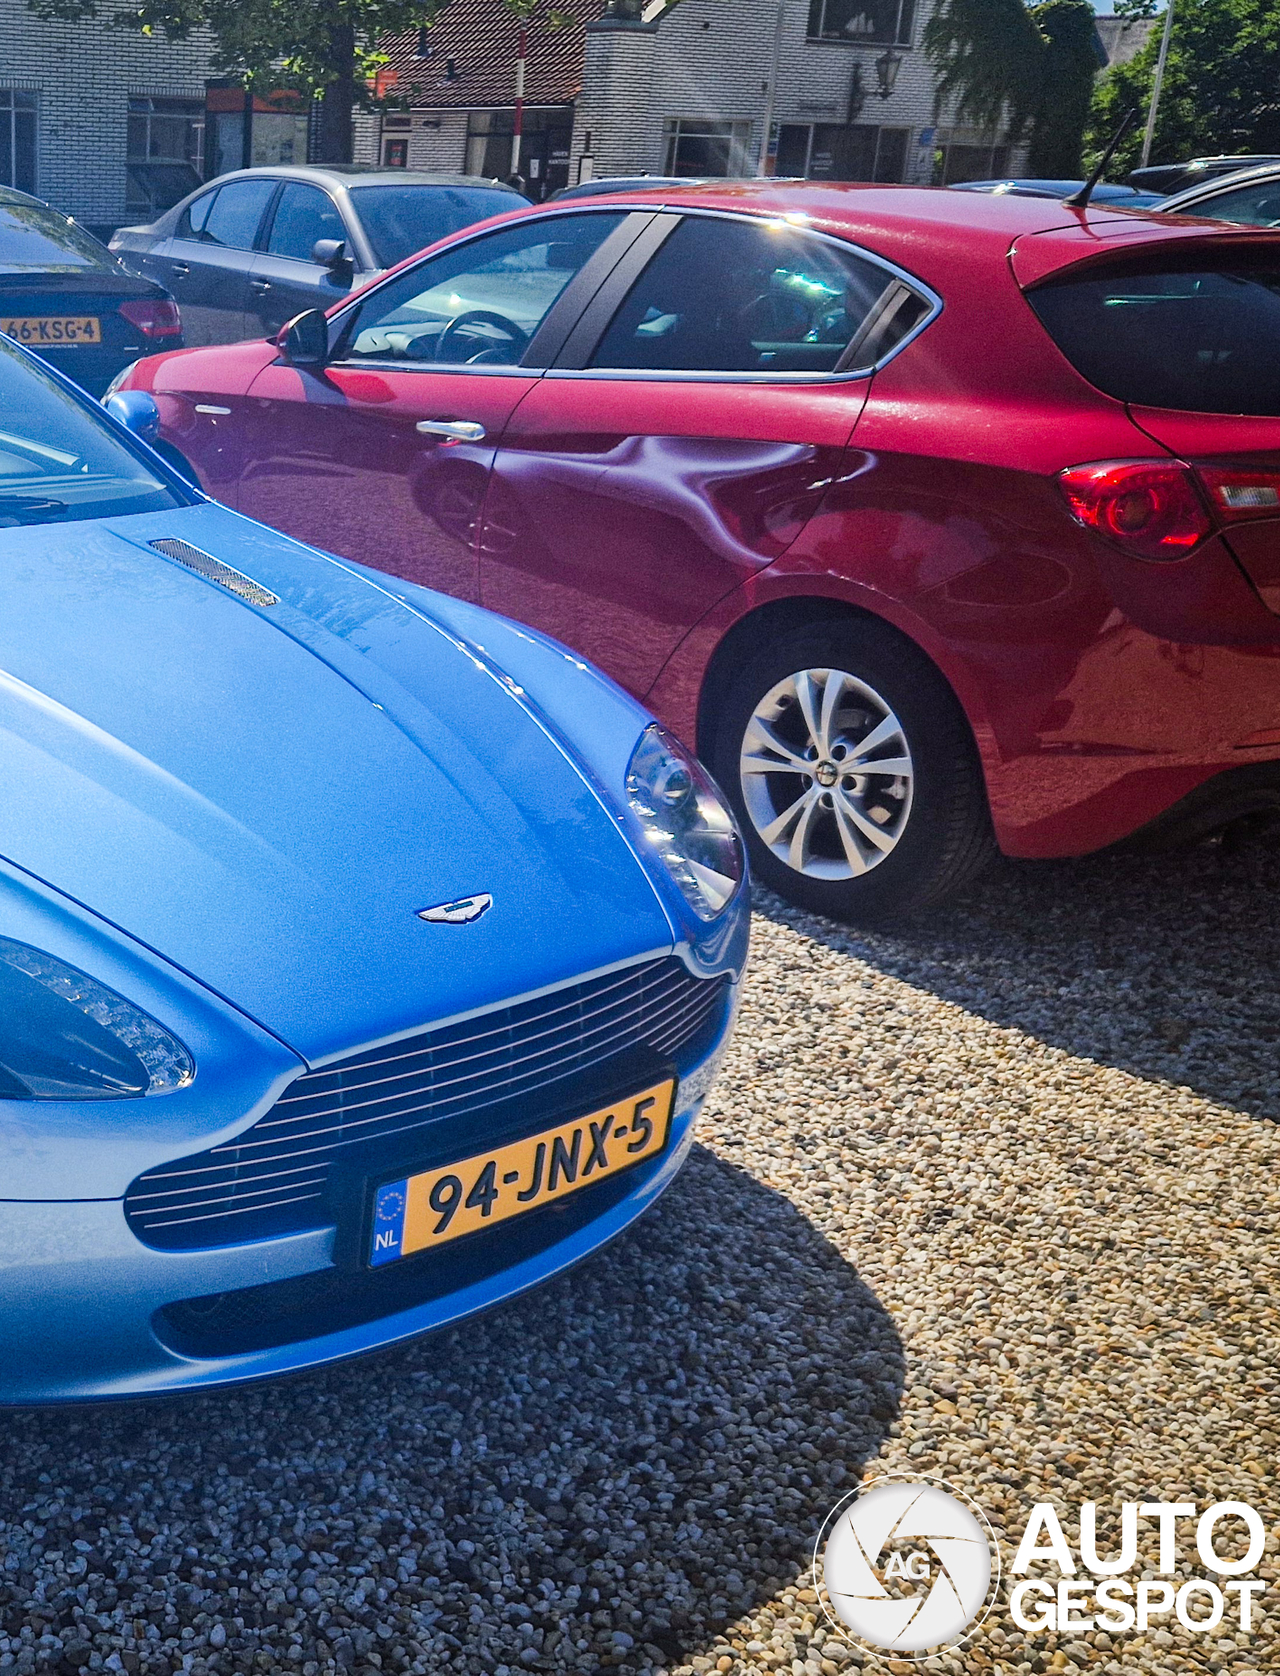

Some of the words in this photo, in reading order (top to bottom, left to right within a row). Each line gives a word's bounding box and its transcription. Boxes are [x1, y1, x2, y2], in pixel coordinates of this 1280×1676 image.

[7, 320, 94, 340] 66-KSG-4
[428, 1096, 656, 1235] 94-JNX-5
[375, 1230, 399, 1251] NL
